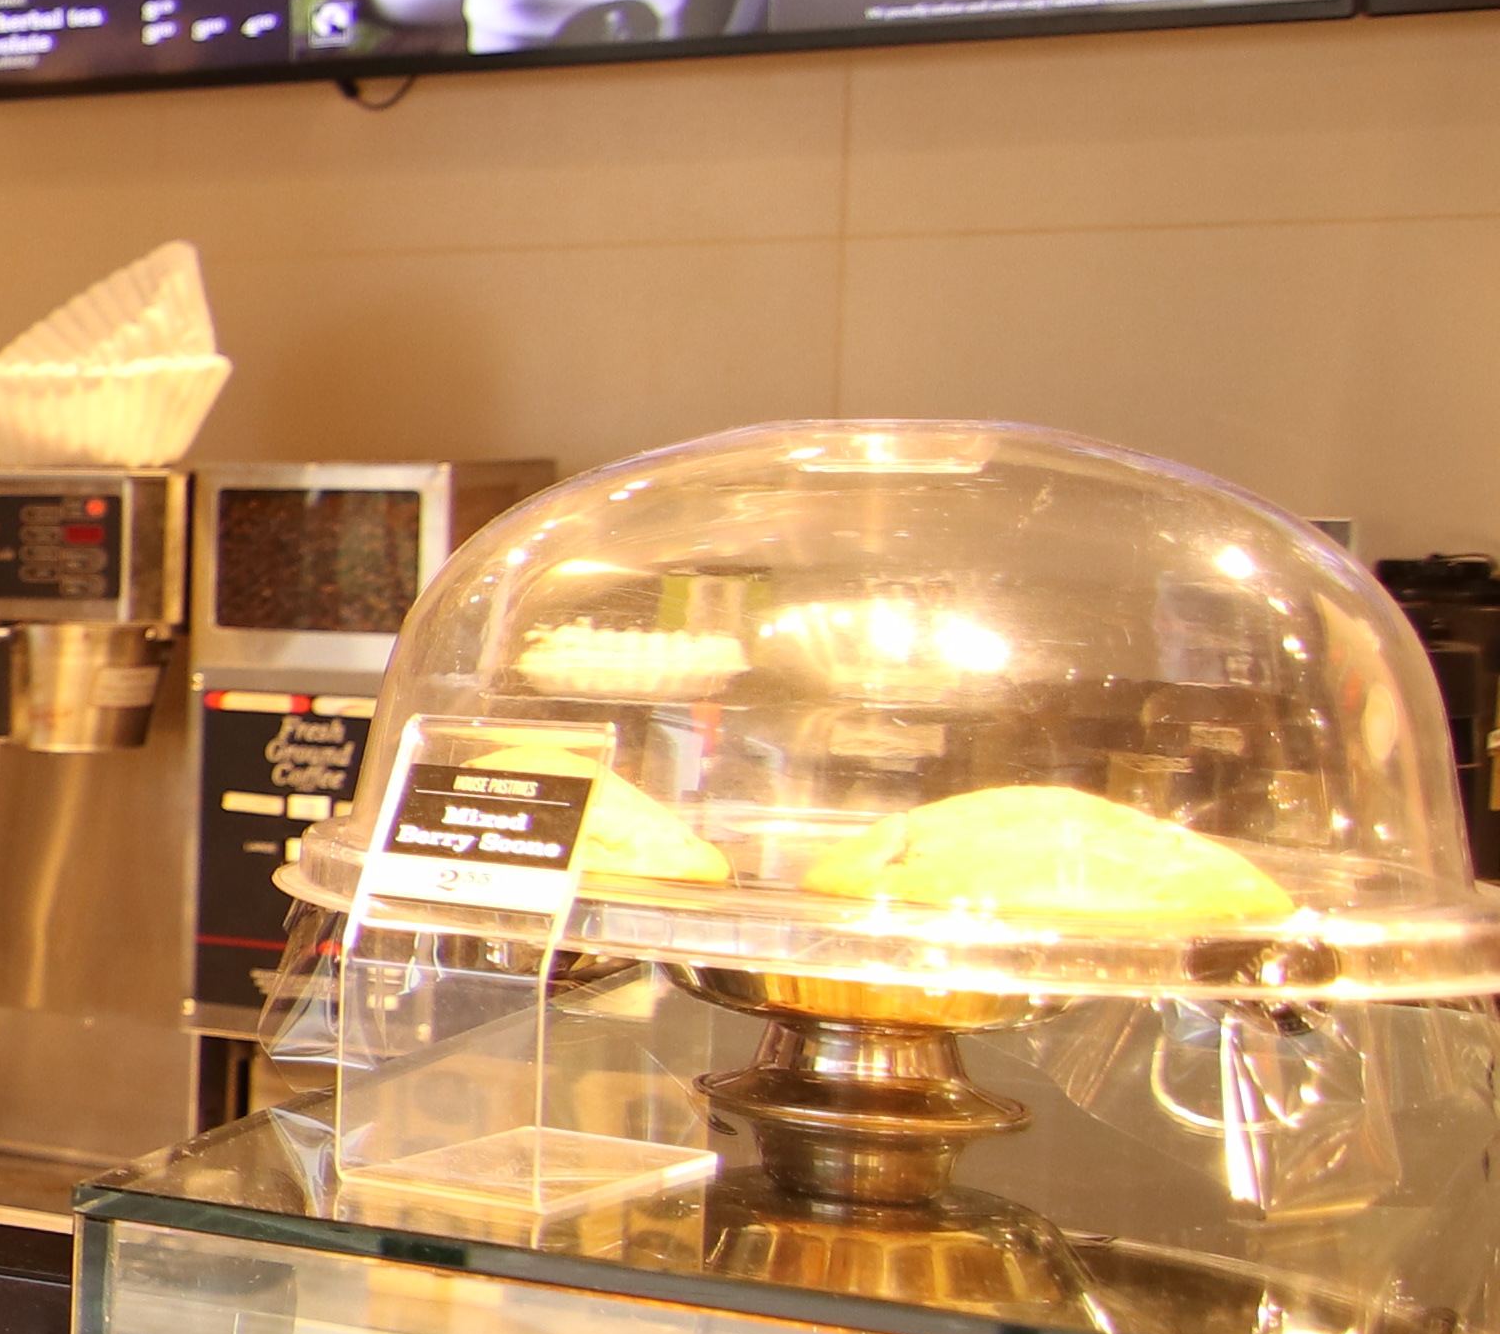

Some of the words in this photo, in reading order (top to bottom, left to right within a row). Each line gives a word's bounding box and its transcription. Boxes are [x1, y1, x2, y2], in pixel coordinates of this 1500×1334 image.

[441, 806, 530, 832] Mixed
[395, 824, 476, 852] Berry
[478, 834, 561, 859] Scone
